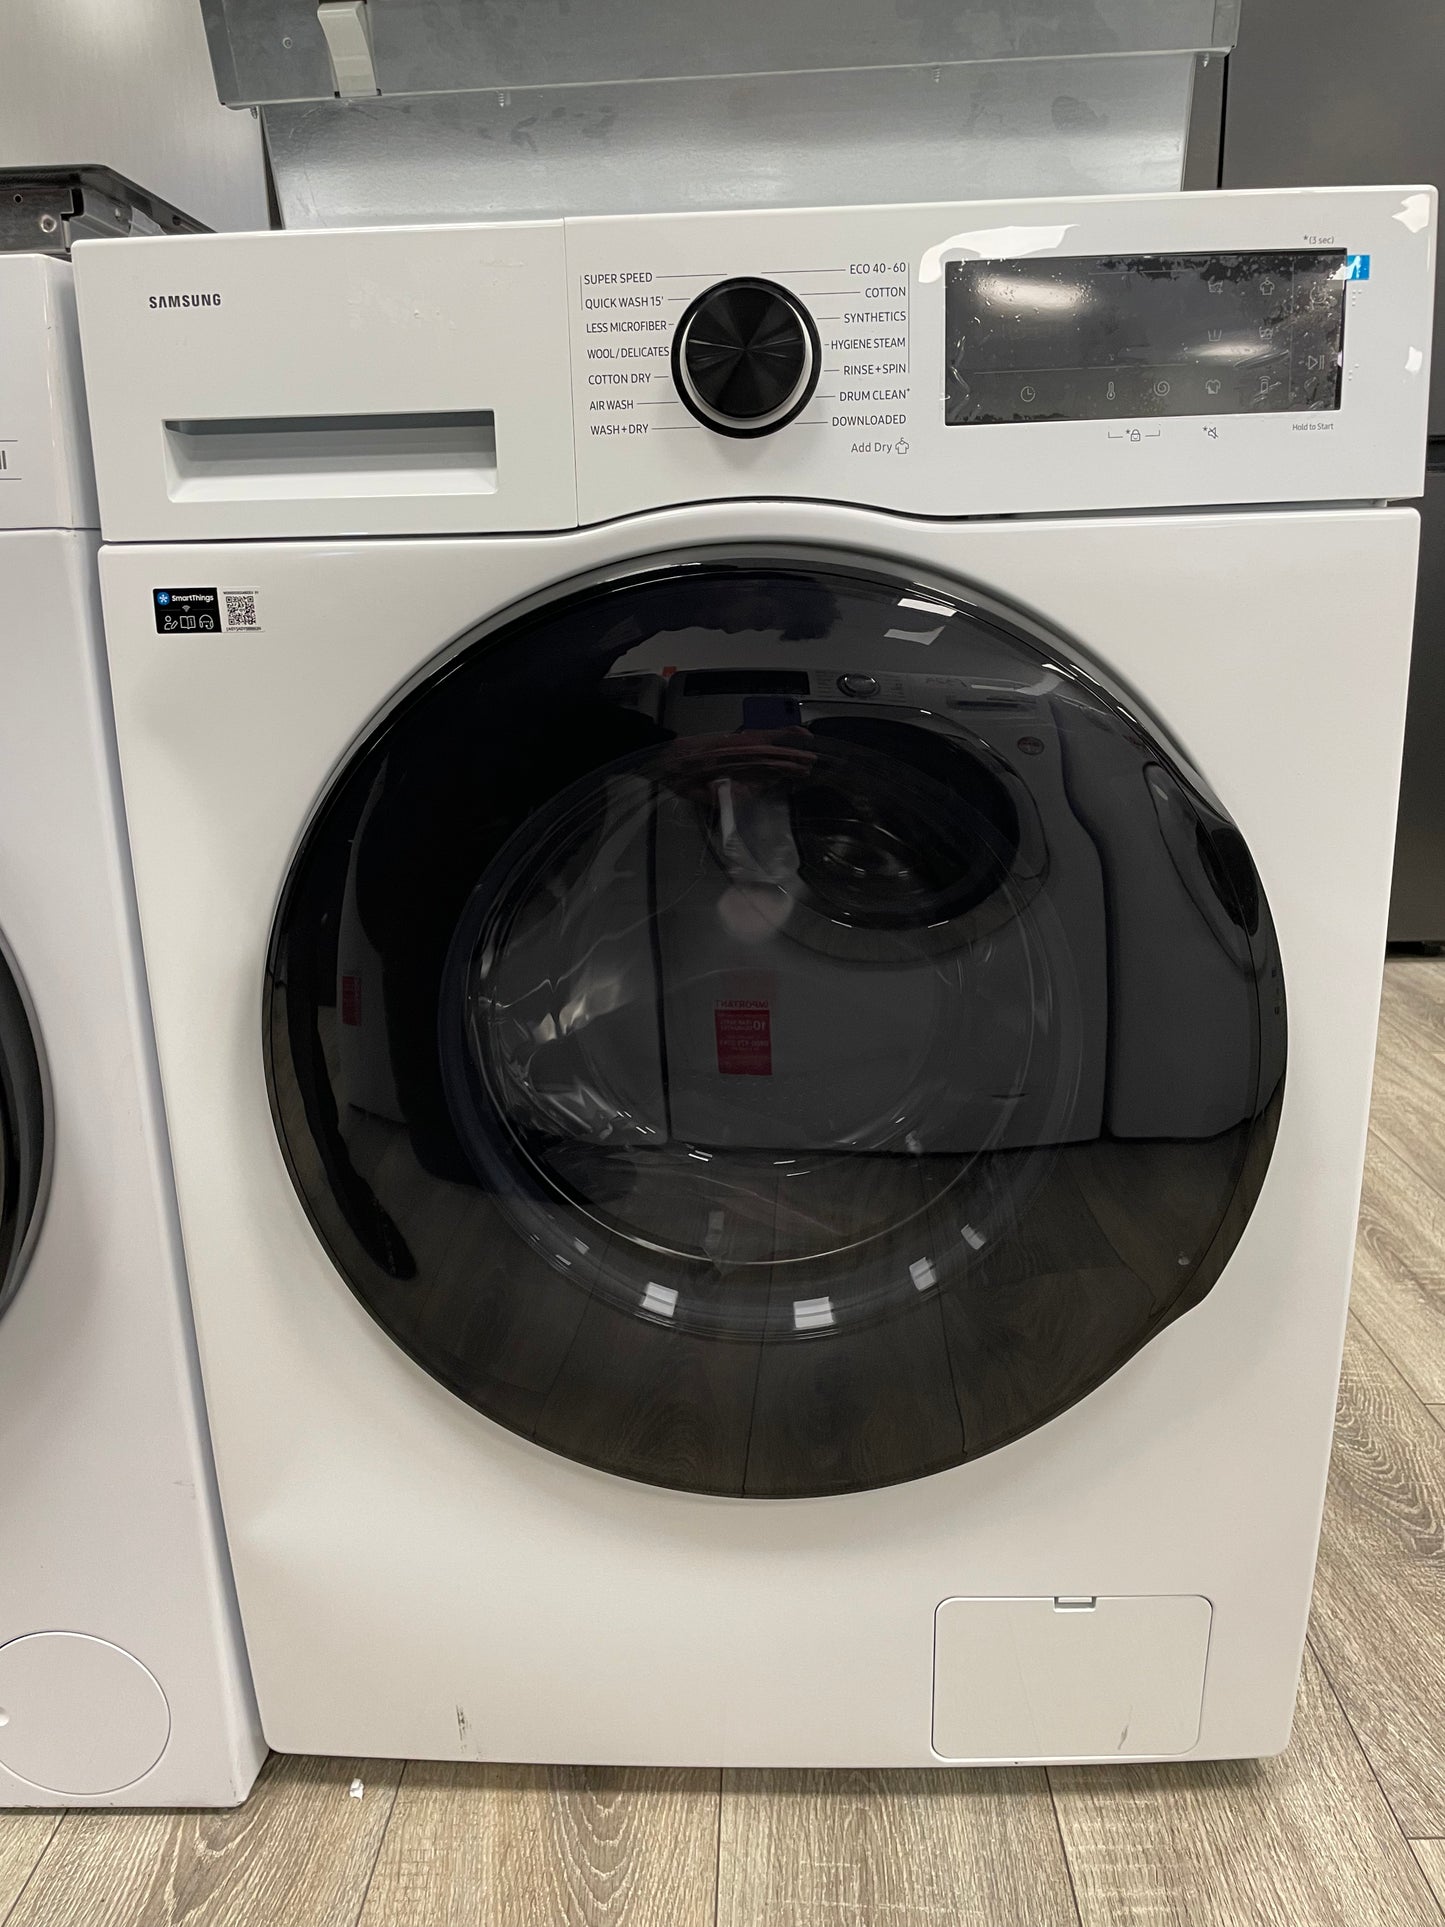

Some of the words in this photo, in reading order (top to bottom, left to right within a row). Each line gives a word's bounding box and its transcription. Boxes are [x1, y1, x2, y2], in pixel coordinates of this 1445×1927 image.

[1319, 236, 1335, 244] sec)
[849, 263, 870, 275] ECO
[583, 273, 618, 285] SUPER
[619, 272, 653, 284] SPEED
[865, 286, 906, 298] COTTON
[149, 293, 221, 309] SAMSUNG
[585, 298, 617, 310] QUICK
[618, 296, 649, 308] WASH
[843, 310, 907, 324] SYNTHETICS
[586, 322, 608, 334] LESS
[610, 320, 667, 333] MICROFIBER
[831, 338, 872, 350] HYGIENE
[873, 337, 906, 349] STEAM
[588, 374, 628, 386] COTTON
[630, 372, 652, 384] DRY
[839, 390, 871, 402] DRUM
[589, 400, 605, 411] AIR
[606, 399, 634, 411] WASH
[832, 414, 907, 427] DOWNLOADED
[1292, 423, 1308, 431] Hold
[1309, 423, 1317, 431] to
[1317, 422, 1334, 431] Start
[850, 442, 872, 453] Add
[874, 441, 893, 454] Dry
[171, 594, 215, 603] SmartThings
